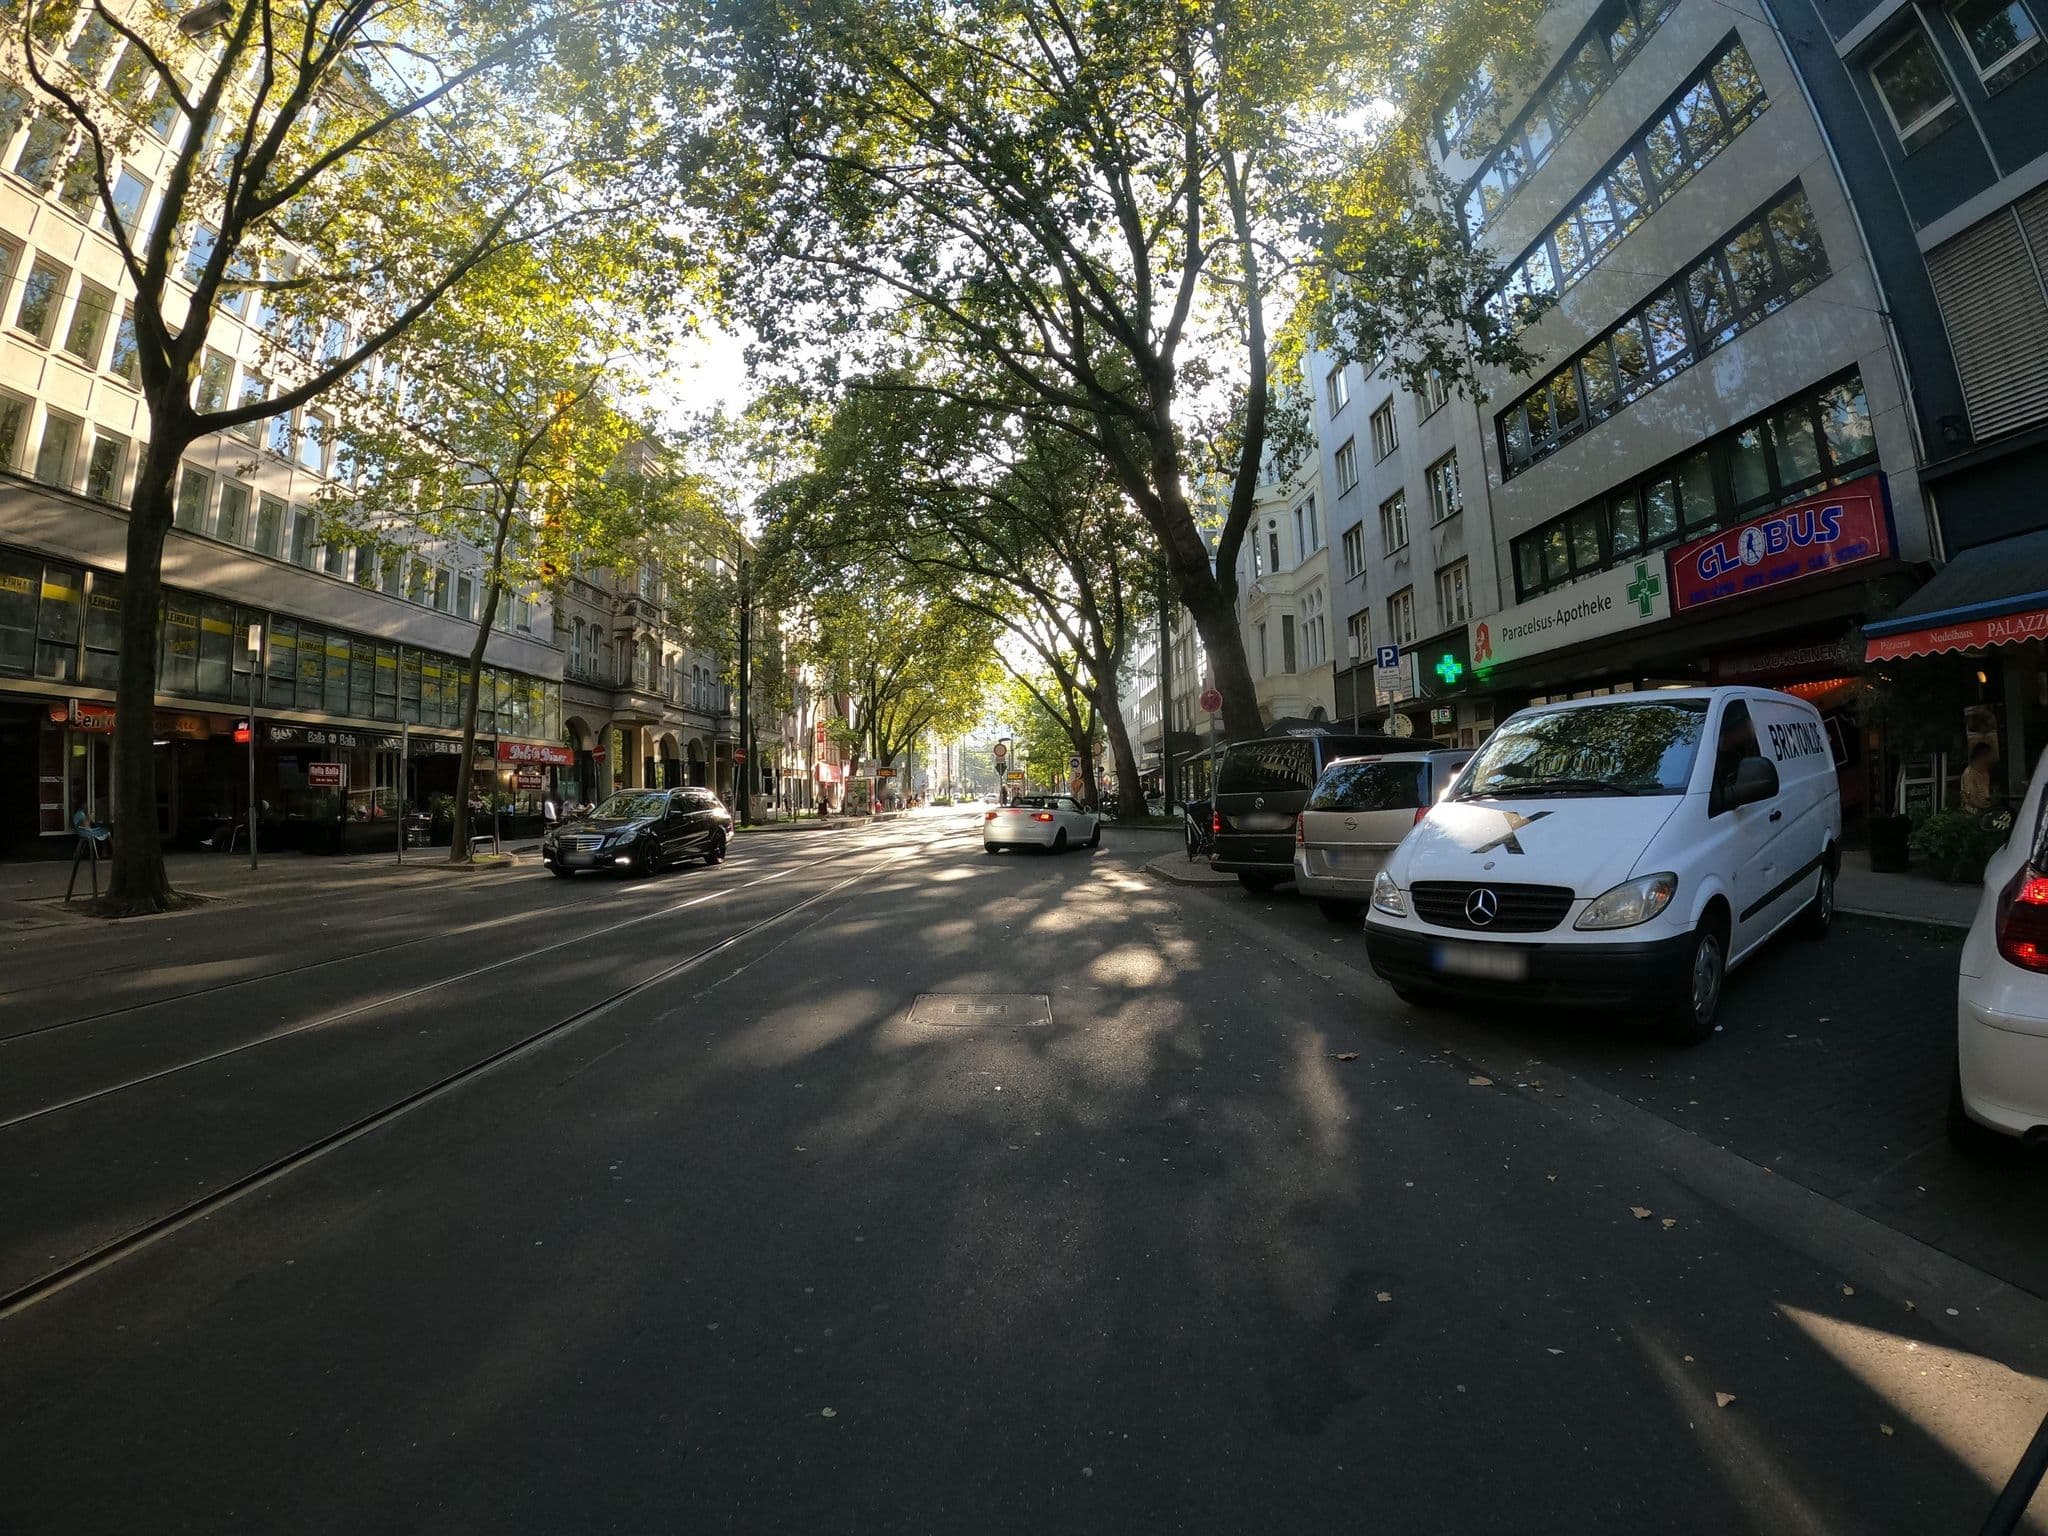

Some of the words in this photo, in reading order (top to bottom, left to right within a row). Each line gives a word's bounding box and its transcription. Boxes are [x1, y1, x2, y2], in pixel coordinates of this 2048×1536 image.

[1696, 505, 1844, 581] GLOBUS
[1502, 595, 1613, 642] Paracelsus-Apotheke
[1381, 648, 1395, 667] P
